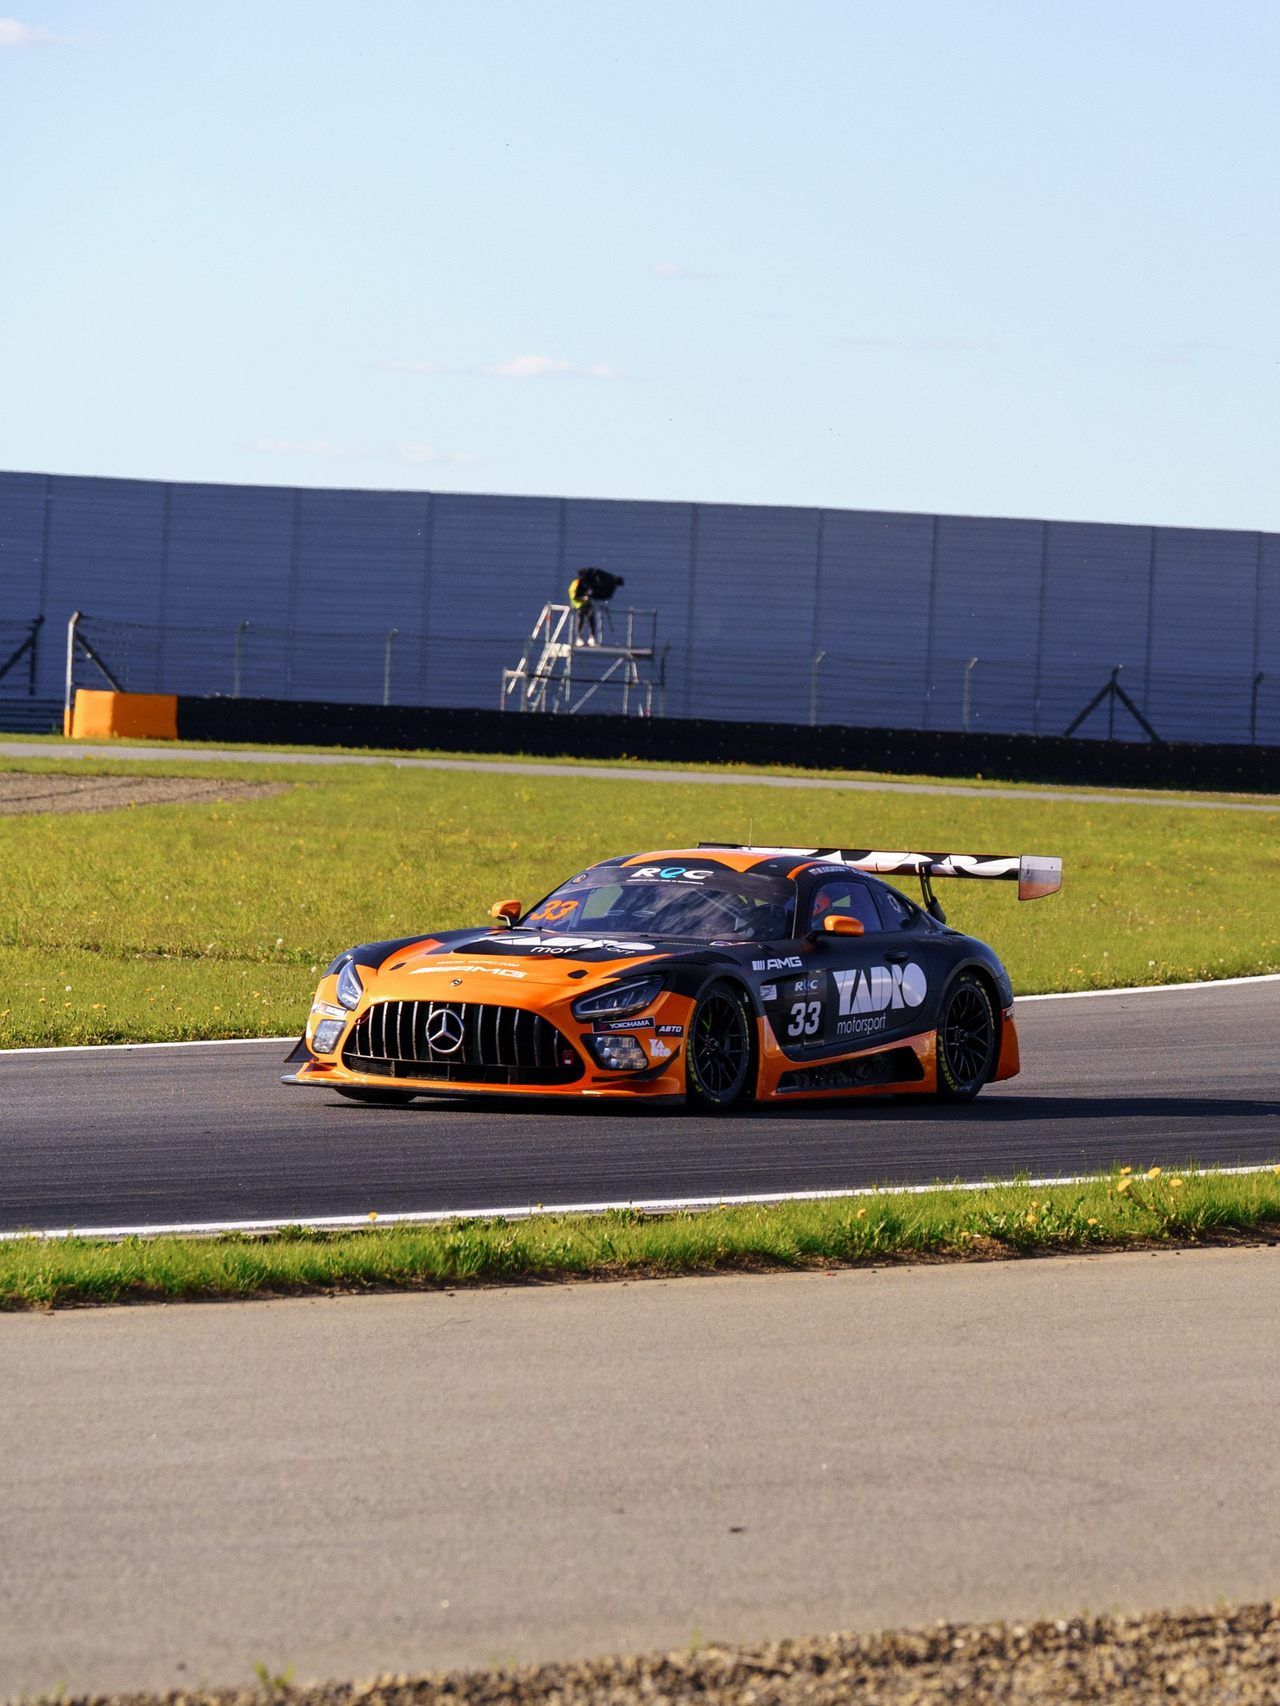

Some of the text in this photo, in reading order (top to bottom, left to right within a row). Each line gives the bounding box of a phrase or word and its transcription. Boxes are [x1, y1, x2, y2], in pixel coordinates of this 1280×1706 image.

[530, 899, 579, 921] 33
[832, 962, 928, 1016] YADRO
[609, 1019, 651, 1030] YOKOHAMA
[787, 1000, 822, 1037] 33
[836, 1012, 887, 1034] motorsport
